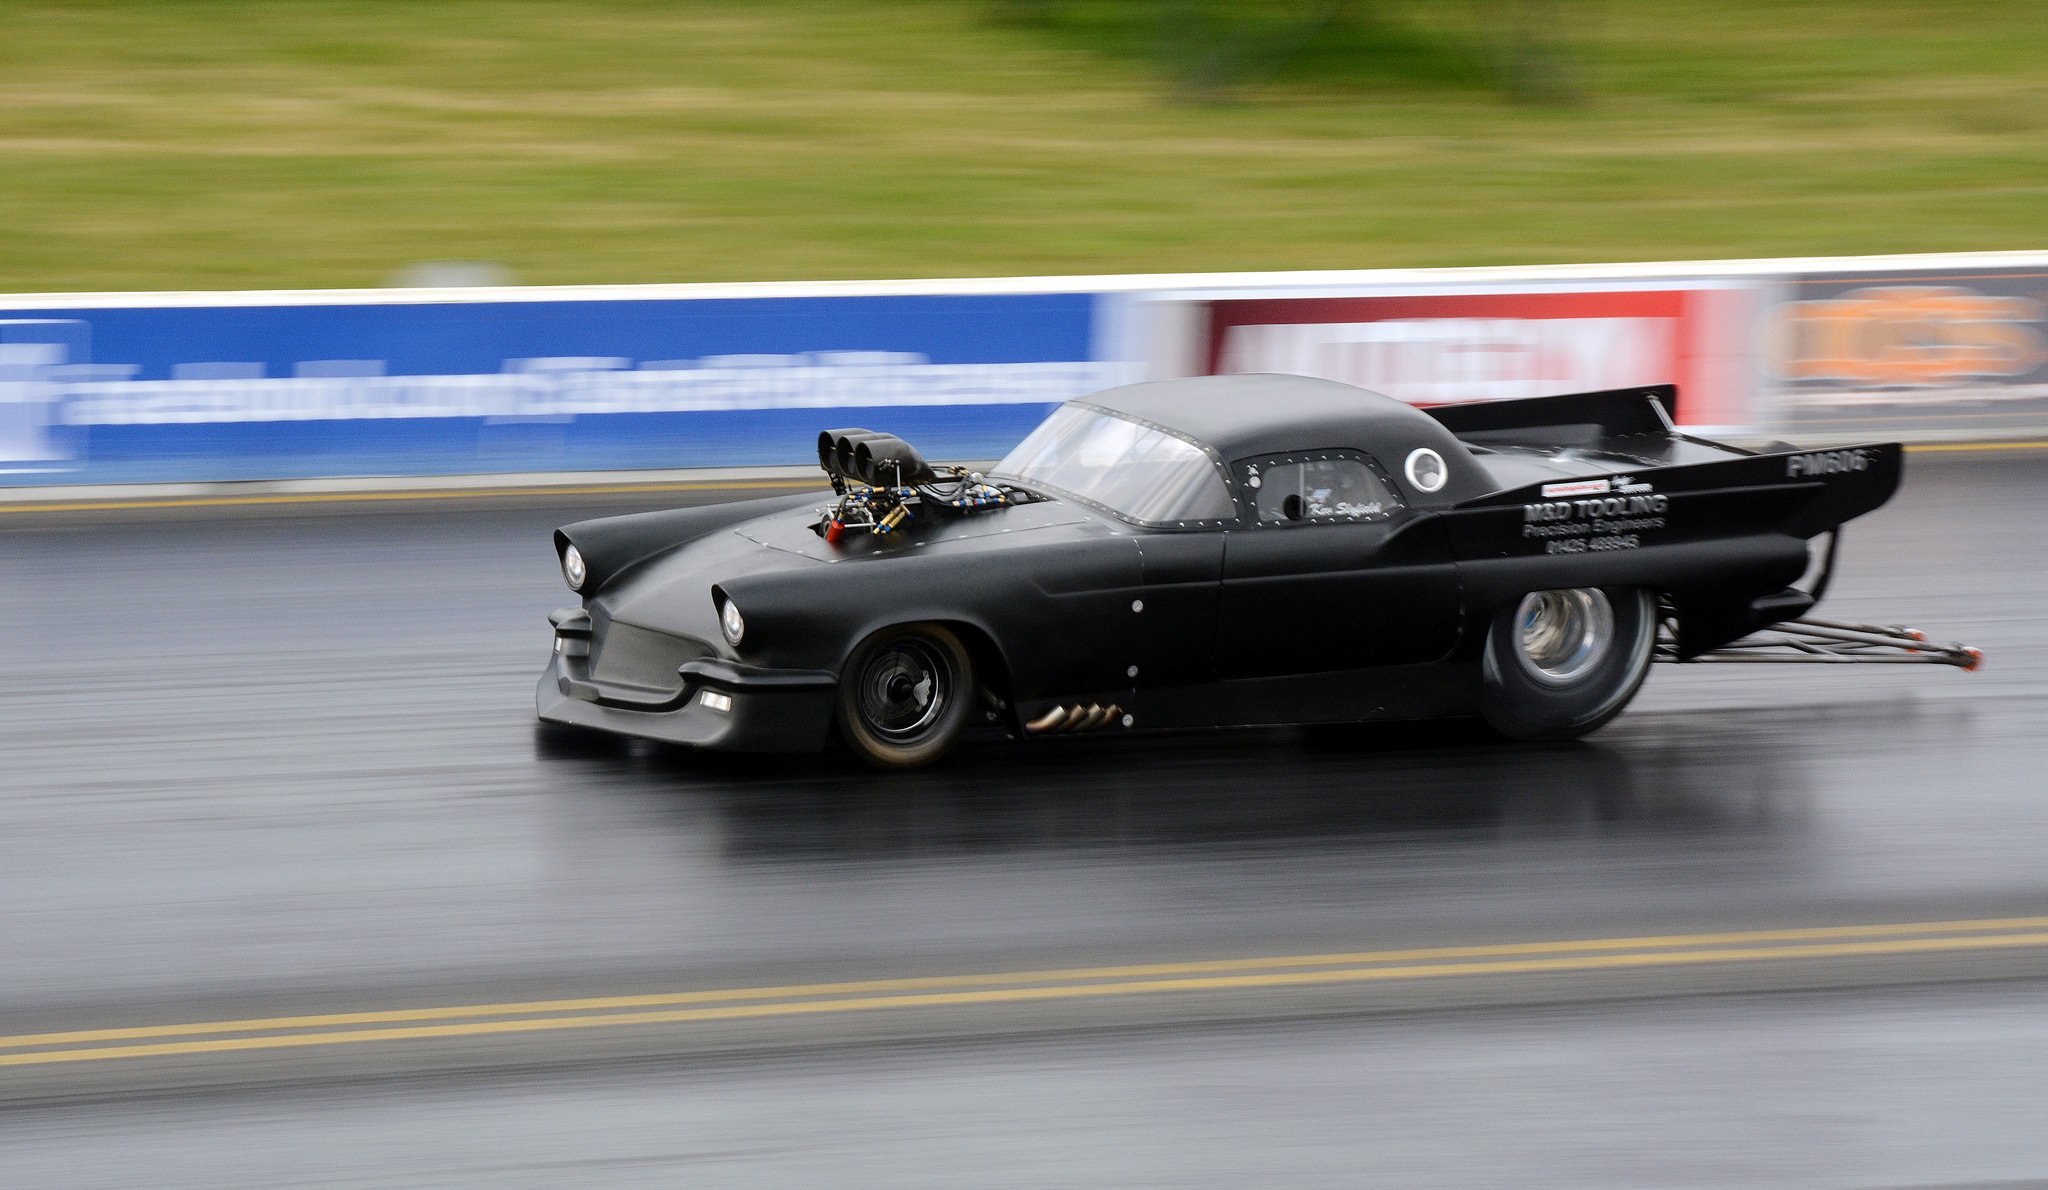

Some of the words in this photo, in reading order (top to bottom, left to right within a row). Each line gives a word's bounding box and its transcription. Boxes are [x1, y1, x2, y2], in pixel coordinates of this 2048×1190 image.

[1574, 494, 1669, 518] TOOLING
[1523, 523, 1591, 539] Precision
[1592, 517, 1666, 534] Engineers
